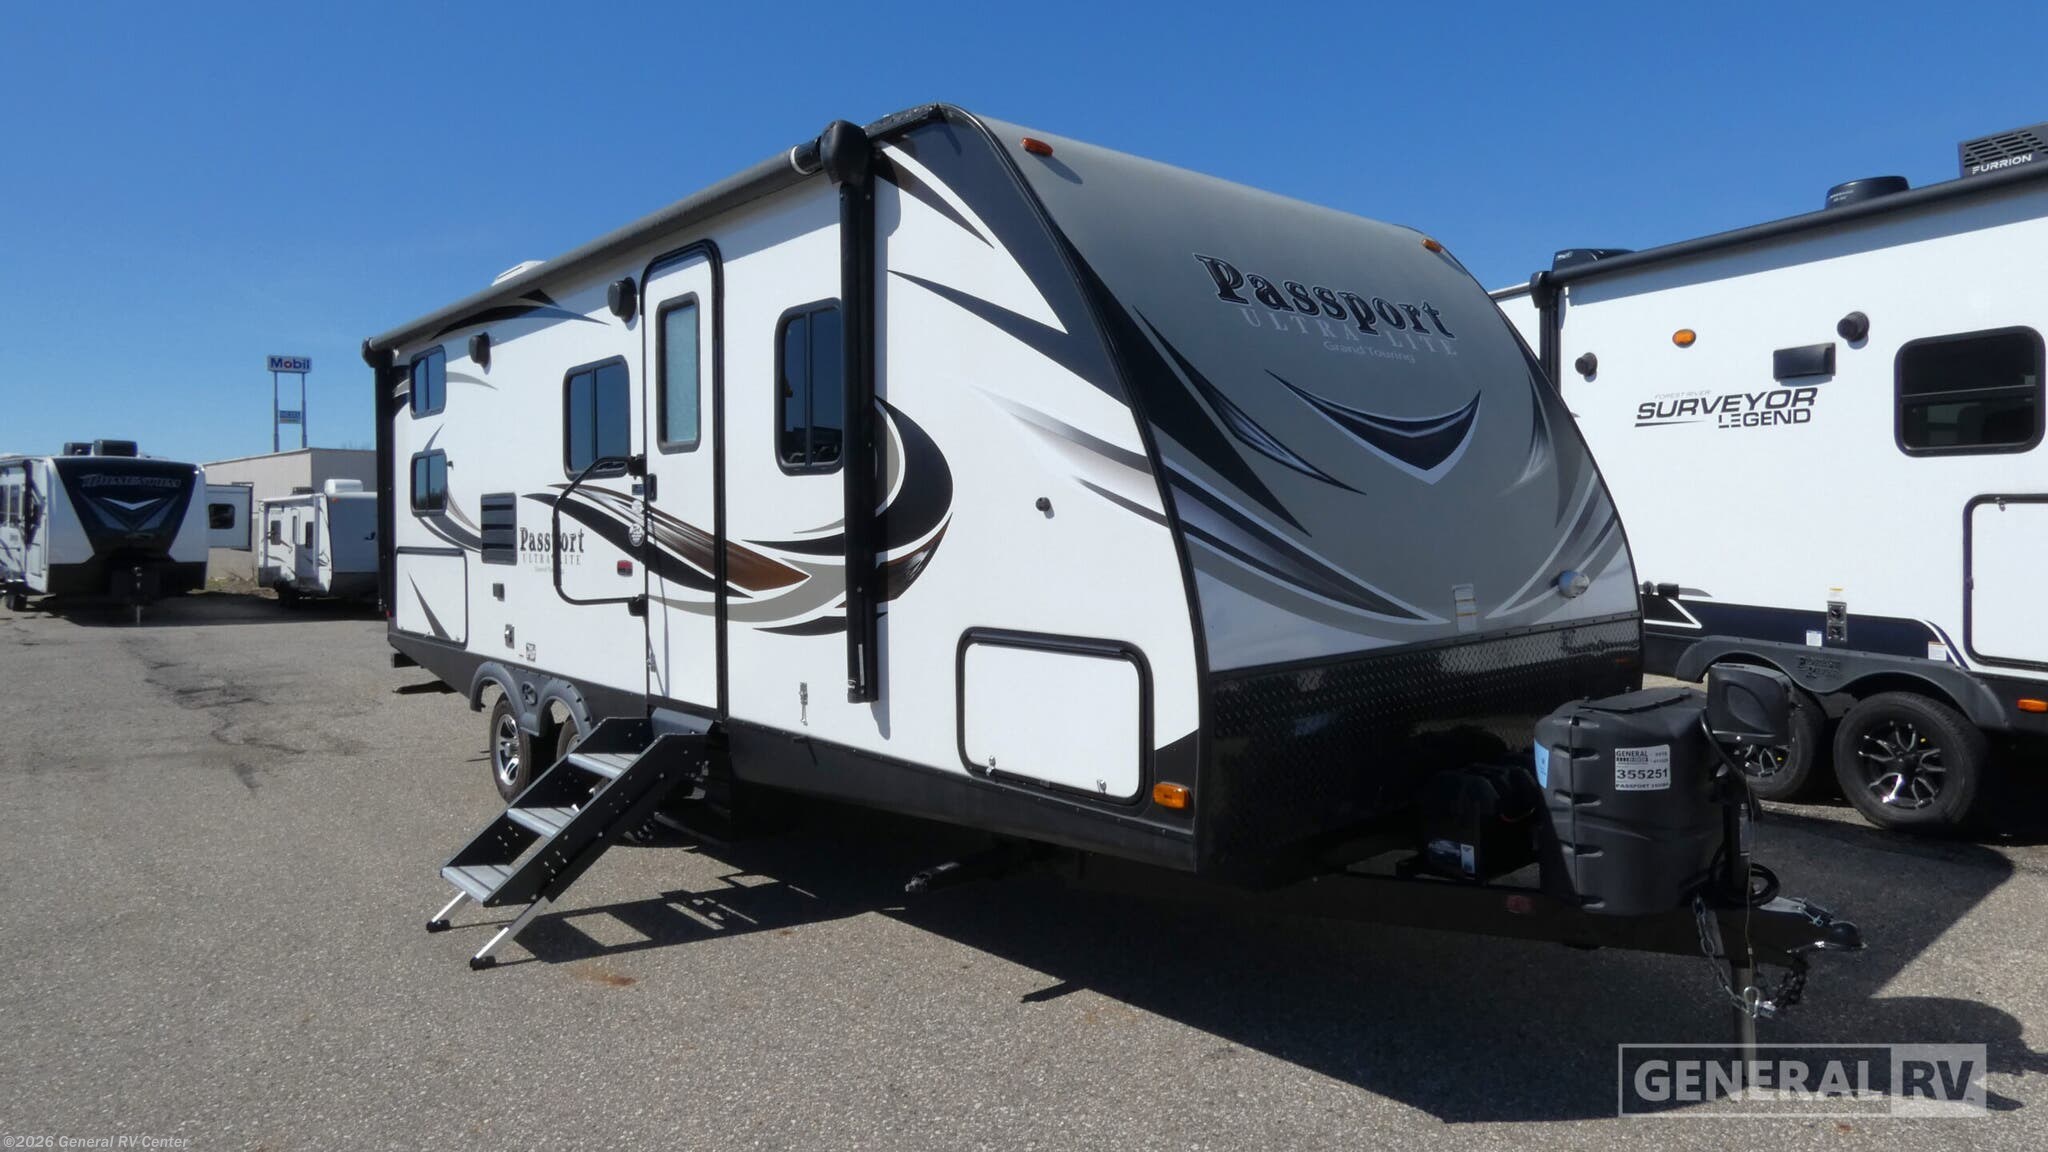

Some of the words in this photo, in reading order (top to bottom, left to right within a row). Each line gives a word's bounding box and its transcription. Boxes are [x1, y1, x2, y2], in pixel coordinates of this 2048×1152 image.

[1972, 153, 2032, 175] FURRION
[1192, 253, 1455, 338] Passport
[1239, 306, 1359, 341] ULTRA
[1385, 330, 1457, 356] LITE
[270, 357, 310, 369] Mobil
[1322, 340, 1366, 354] Grand
[1368, 347, 1416, 364] Touring
[1636, 387, 1818, 420] SURVEYOR
[1718, 408, 1812, 429] LEGEND
[519, 527, 584, 553] Passort
[560, 554, 581, 566] ITE
[1616, 768, 1667, 780] 355251
